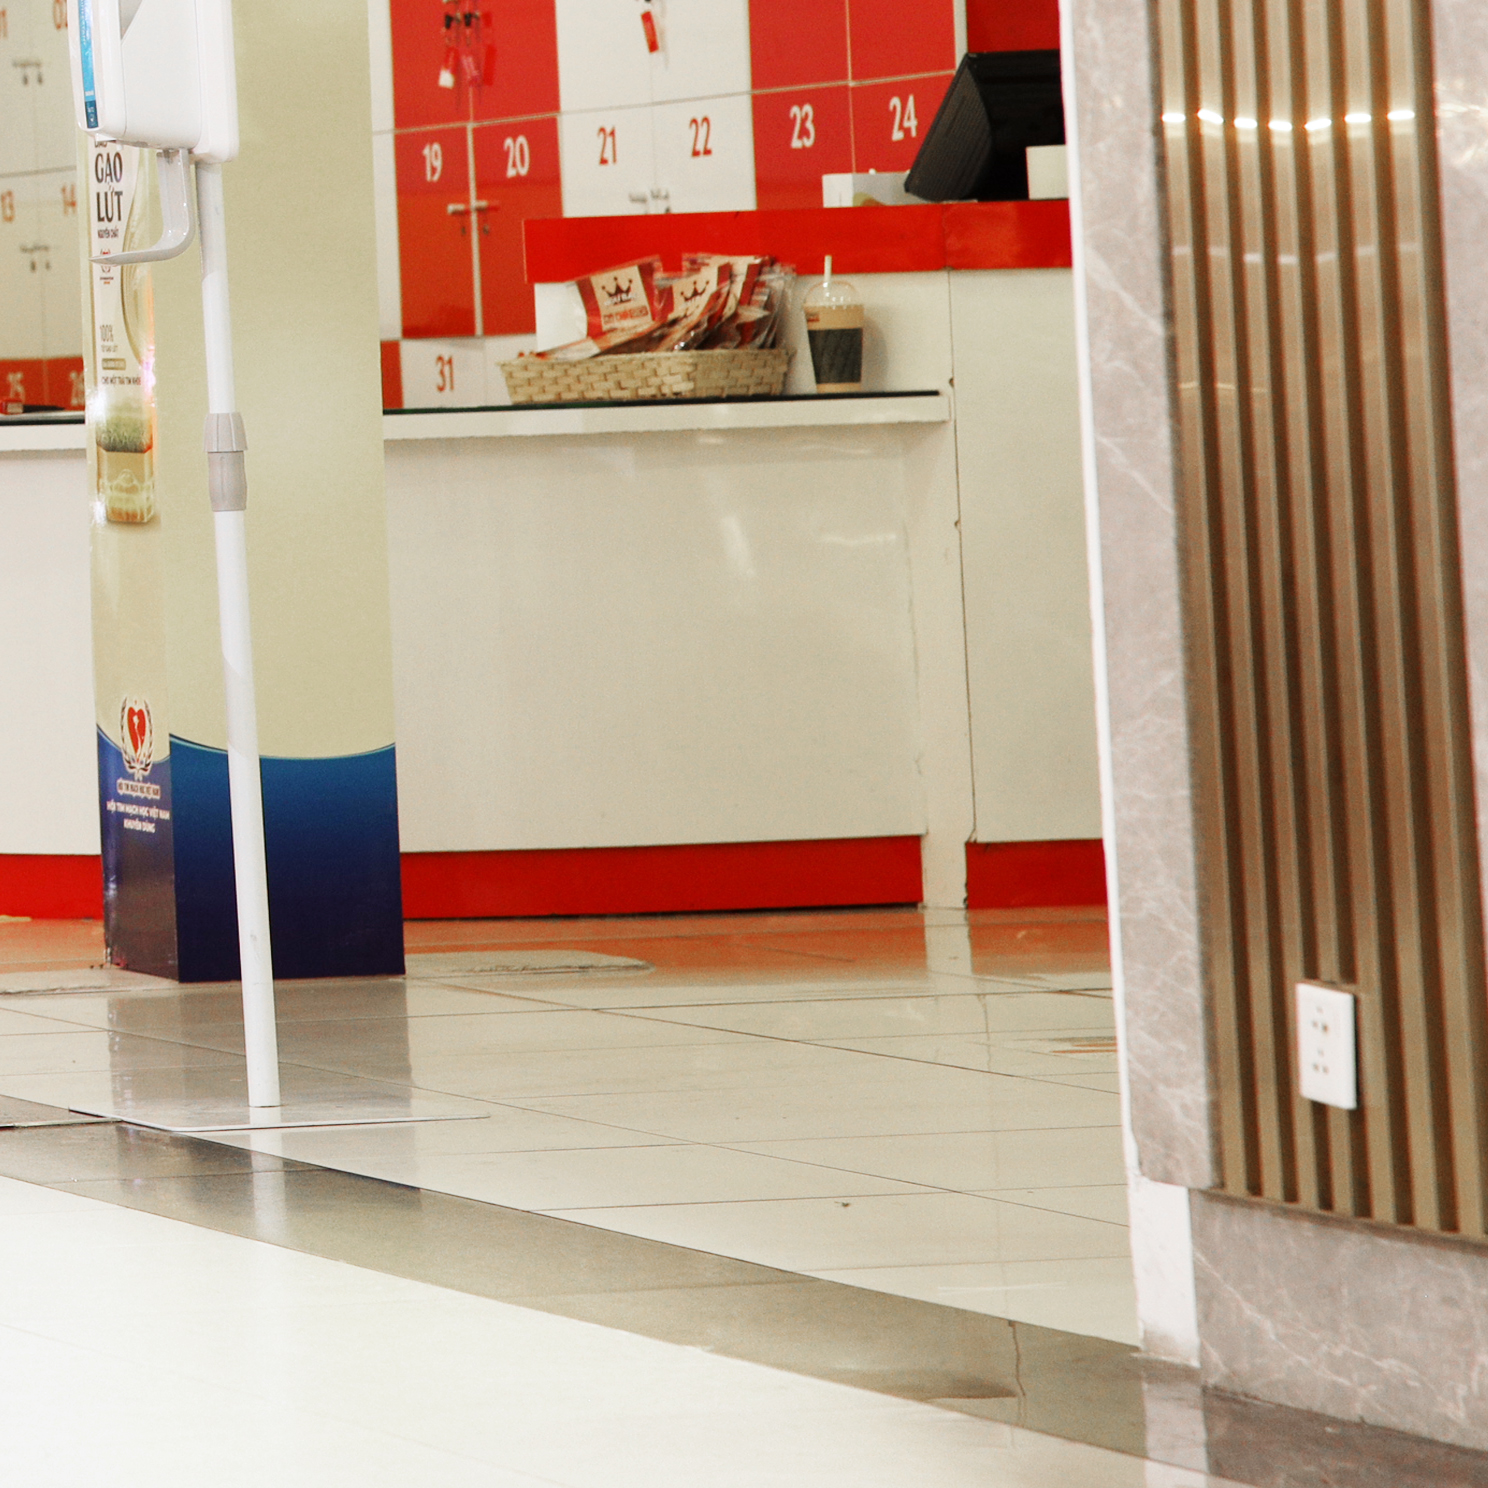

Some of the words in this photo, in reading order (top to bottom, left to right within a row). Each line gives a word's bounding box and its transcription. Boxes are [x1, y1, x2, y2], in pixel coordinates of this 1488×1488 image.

[689, 116, 712, 158] 22
[790, 104, 815, 149] 23
[890, 94, 918, 142] 24
[422, 143, 443, 182] 19
[504, 135, 530, 178] 20
[598, 127, 617, 165] 21
[95, 152, 123, 185] GẠO
[96, 185, 123, 223] LỨT
[436, 355, 455, 393] 31
